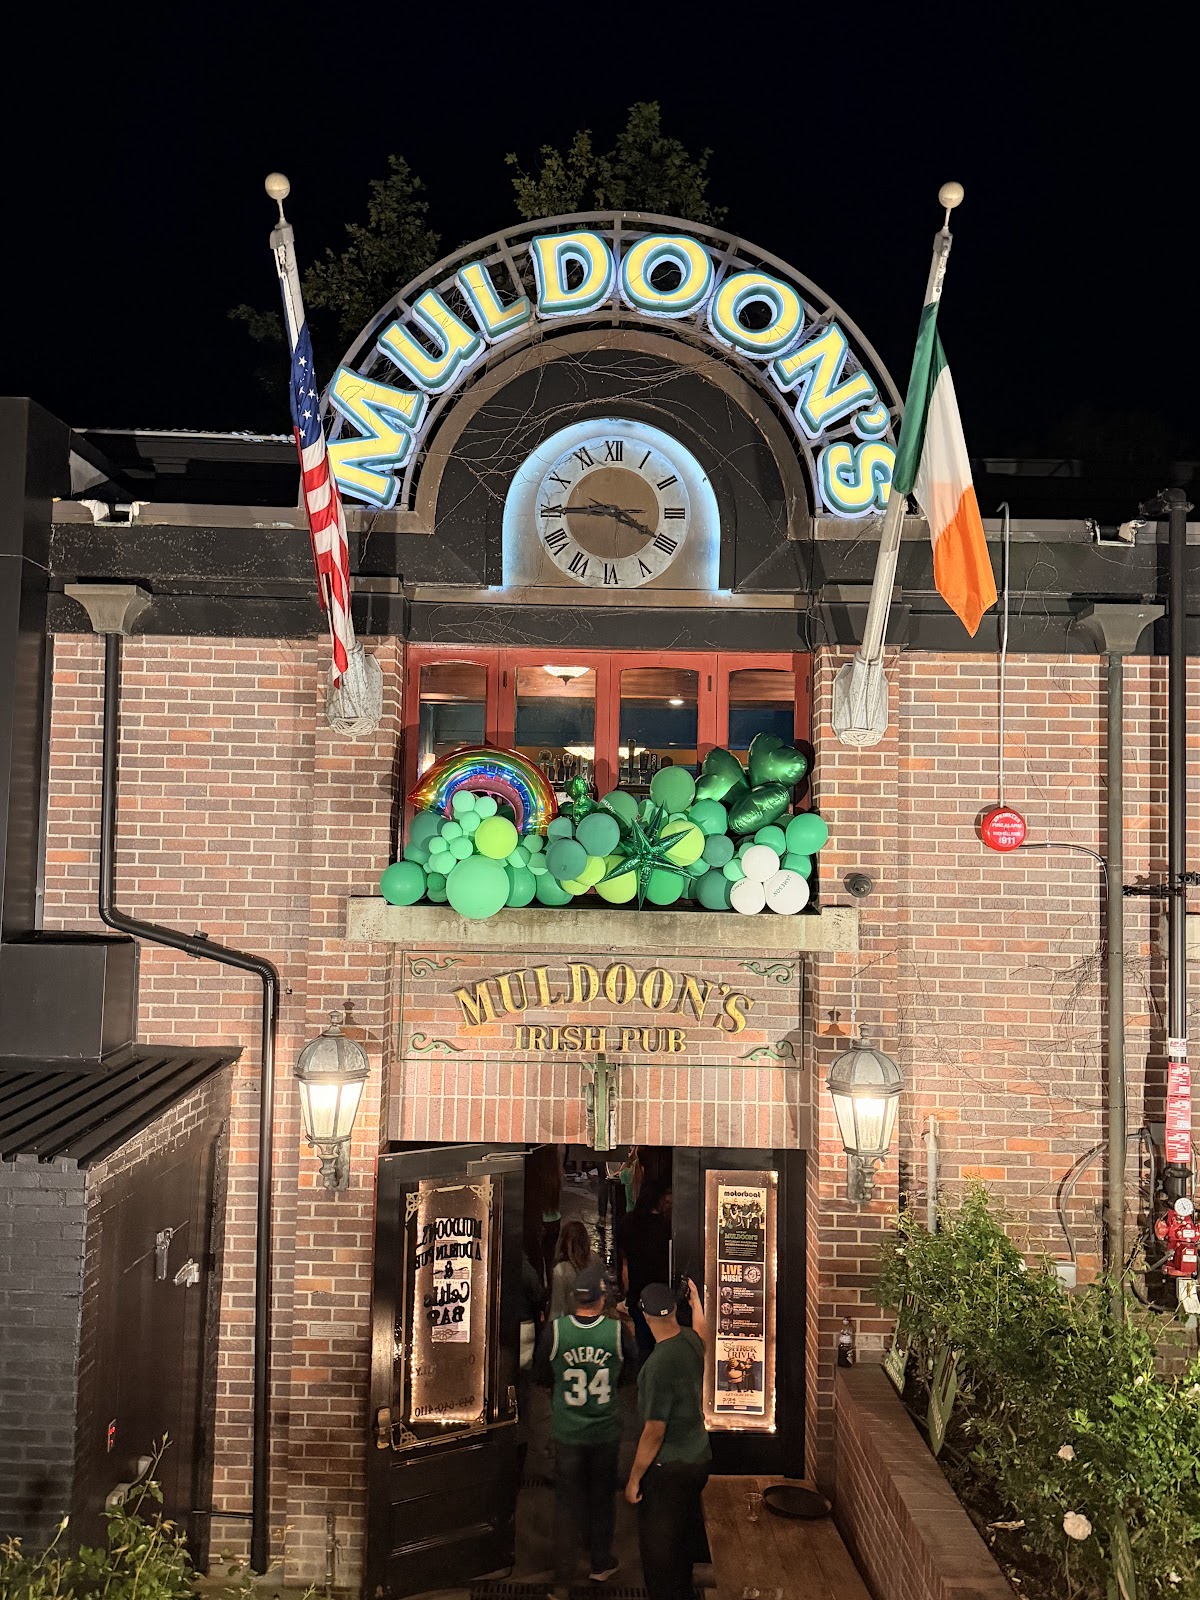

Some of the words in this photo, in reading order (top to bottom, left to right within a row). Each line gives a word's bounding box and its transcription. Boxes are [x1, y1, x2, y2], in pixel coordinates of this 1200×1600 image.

[328, 230, 897, 519] MULDOON'S
[572, 446, 595, 471] XI
[604, 440, 624, 462] XII
[638, 450, 652, 470] I
[548, 471, 571, 490] X
[656, 474, 678, 491] II
[664, 507, 685, 520] III
[544, 528, 570, 556] VIII
[567, 551, 589, 578] VII
[603, 563, 619, 585] VI
[637, 557, 653, 578] V
[1002, 836, 1016, 844] 911
[453, 961, 755, 1035] MULDOON'S
[513, 1024, 607, 1052] IRISH
[617, 1026, 687, 1054] PUB
[723, 1190, 761, 1198] motorboat
[721, 1263, 743, 1275] LIVE
[721, 1274, 743, 1283] MUSIC
[563, 1346, 612, 1367] PIERCE
[723, 1341, 757, 1354] SHREK
[727, 1351, 756, 1360] TRIVIA
[563, 1368, 612, 1407] 34
